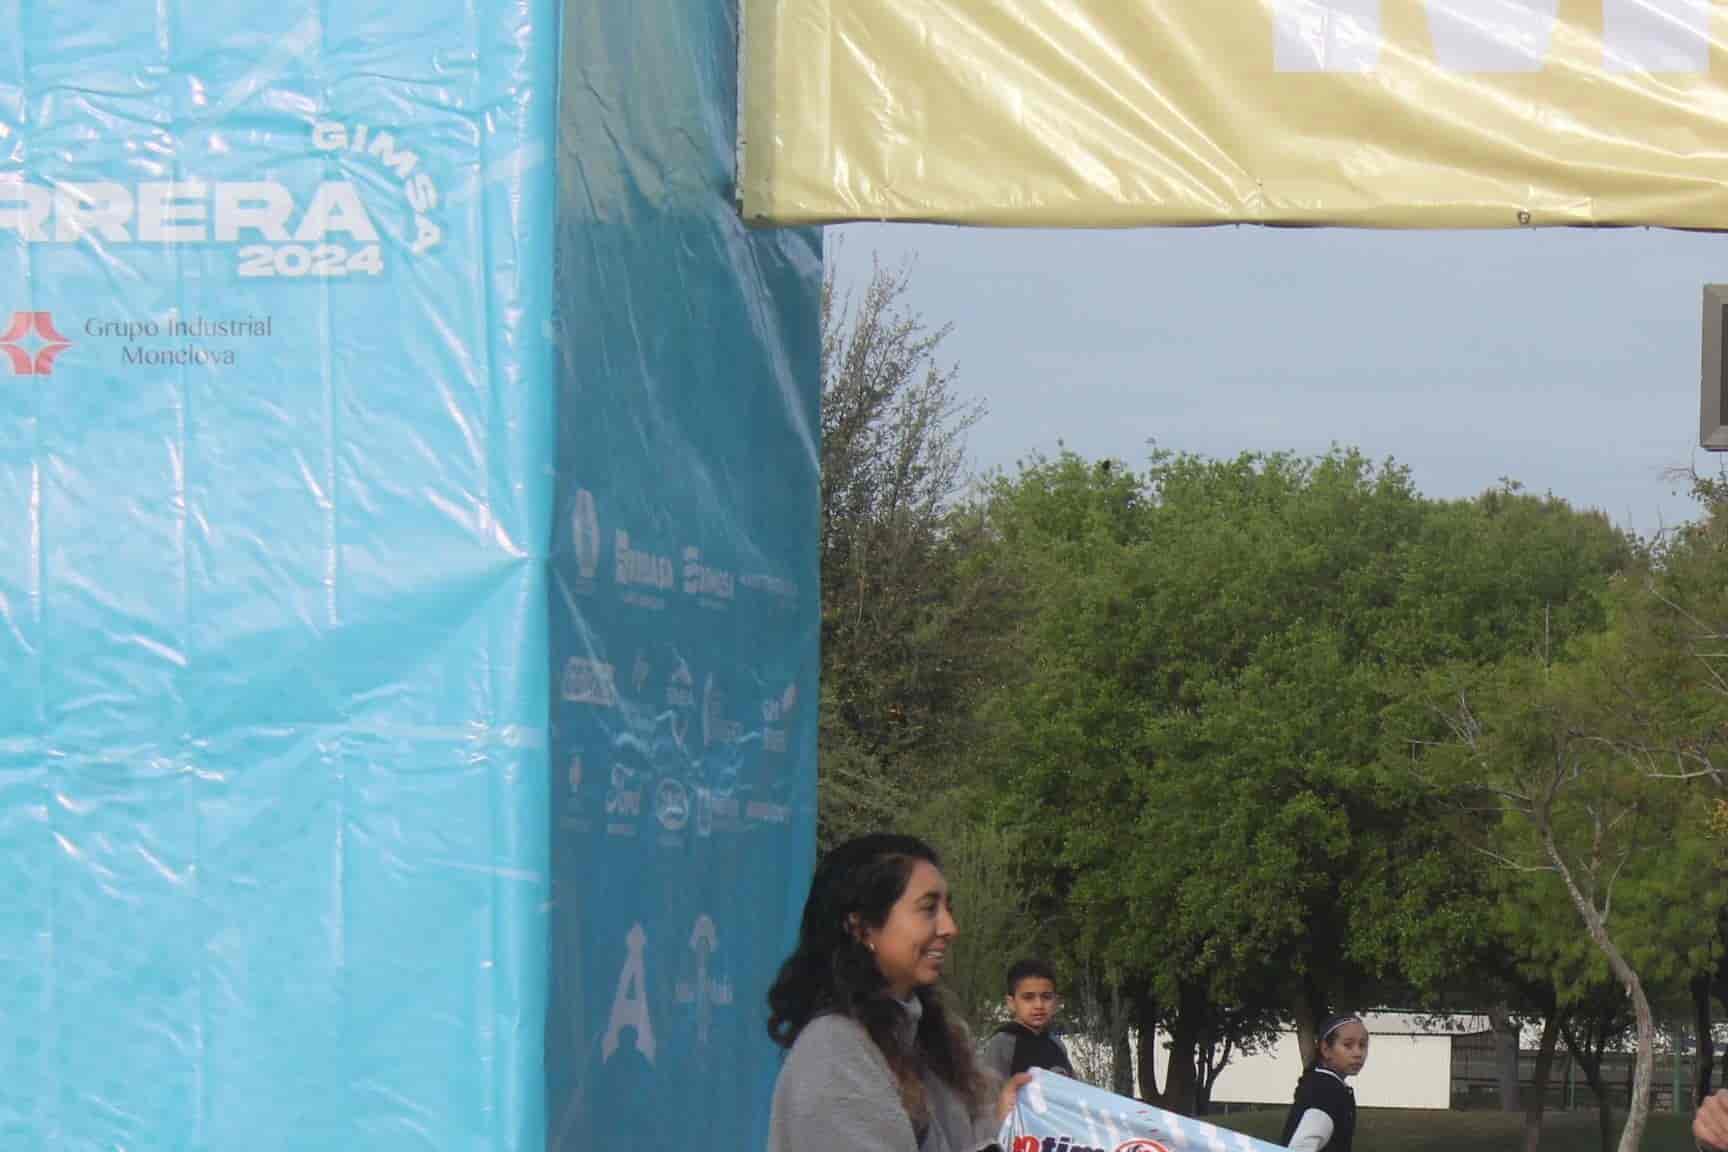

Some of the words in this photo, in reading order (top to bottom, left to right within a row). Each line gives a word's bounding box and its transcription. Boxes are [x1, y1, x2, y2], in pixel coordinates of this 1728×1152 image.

[312, 121, 443, 255] GIMSA
[238, 244, 385, 278] 2024
[84, 316, 159, 338] Grupo
[166, 314, 273, 337] Industrial
[121, 343, 236, 366] Monclova
